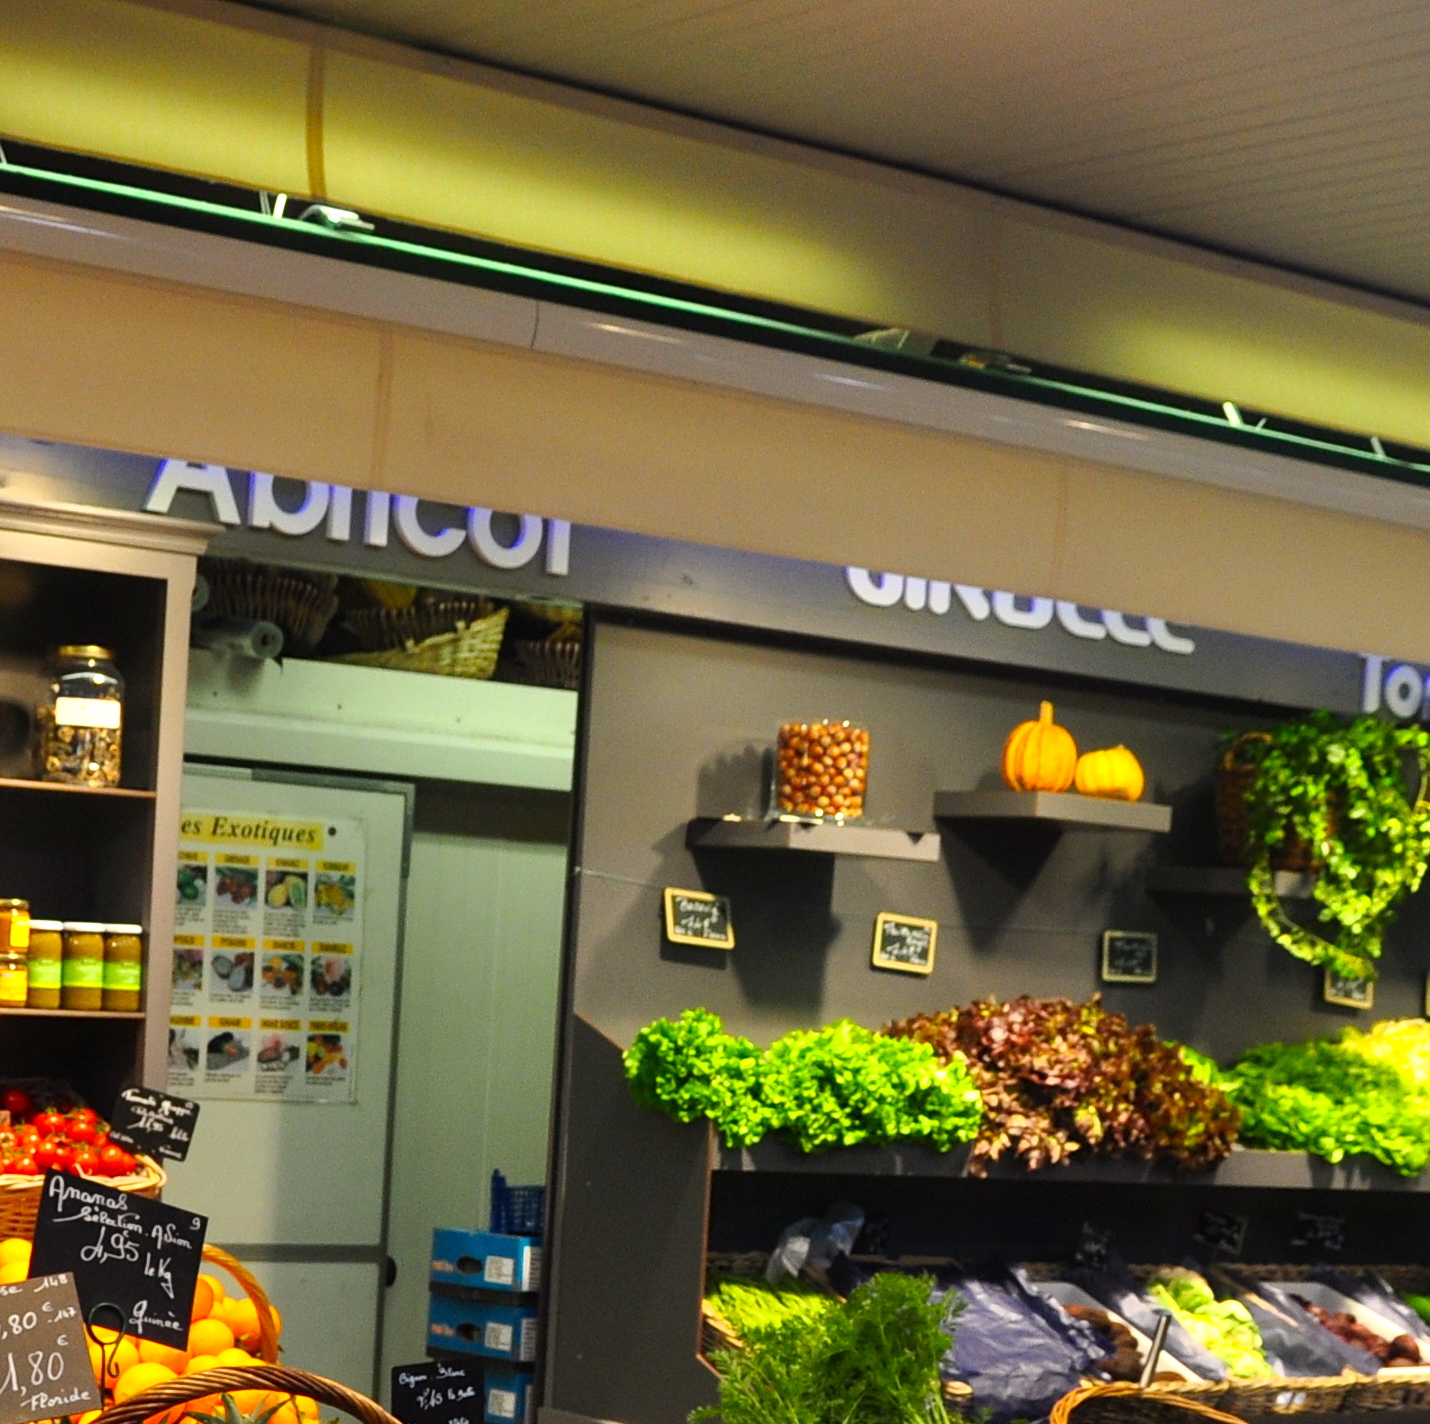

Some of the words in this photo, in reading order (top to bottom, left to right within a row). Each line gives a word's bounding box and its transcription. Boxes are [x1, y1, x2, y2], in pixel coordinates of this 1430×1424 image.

[211, 816, 317, 846] Exotiques
[48, 1175, 128, 1212] Ananas
[20, 1389, 92, 1411] Floride
